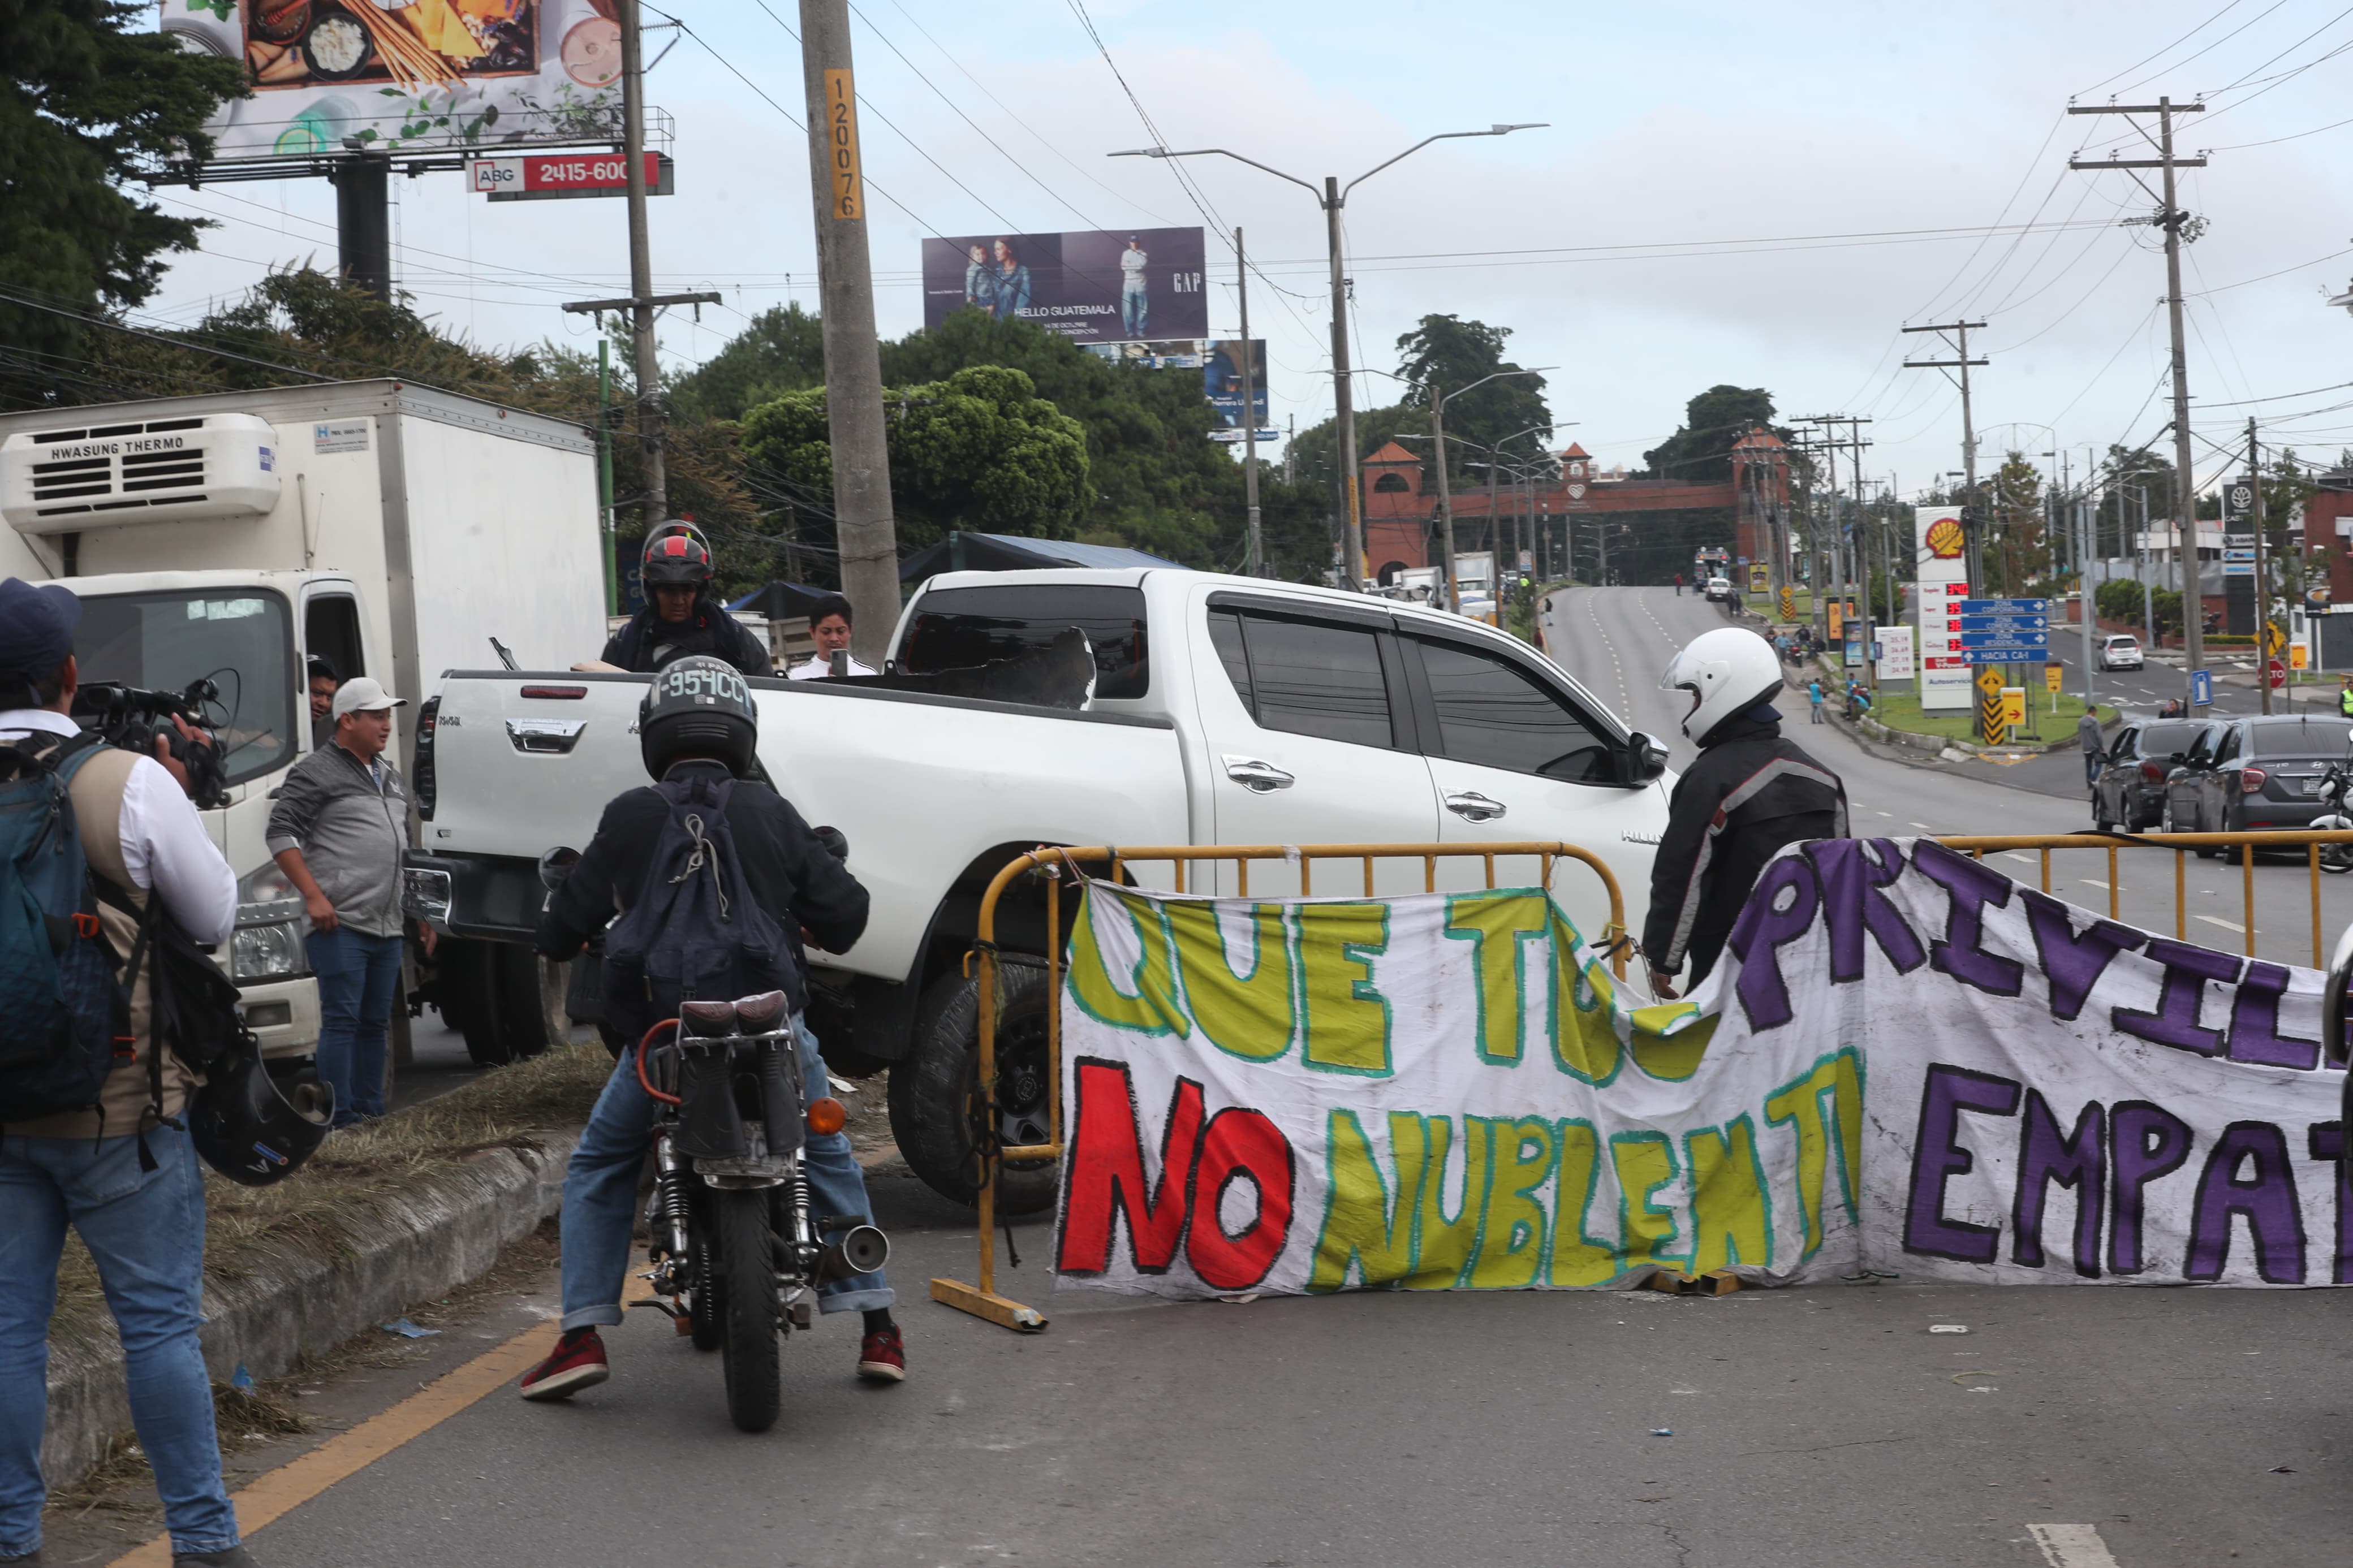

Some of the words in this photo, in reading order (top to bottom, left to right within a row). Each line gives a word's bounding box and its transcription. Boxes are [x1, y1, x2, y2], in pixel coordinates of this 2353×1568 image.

[835, 77, 854, 217] 120076
[480, 169, 514, 183] ABG
[540, 161, 627, 182] 2415-600
[1174, 272, 1201, 293] GAP
[1014, 307, 1049, 317] HELLO
[1050, 305, 1116, 316] GUATEMALA
[52, 443, 119, 459] HWASUNG
[125, 437, 183, 452] THERMO
[1981, 651, 2008, 660] HACIA
[1066, 880, 1394, 1078] QUE
[1729, 837, 2347, 1071] PRIVIL
[1055, 1055, 1296, 1291] NO
[1304, 1106, 1775, 1295] NUBLEN
